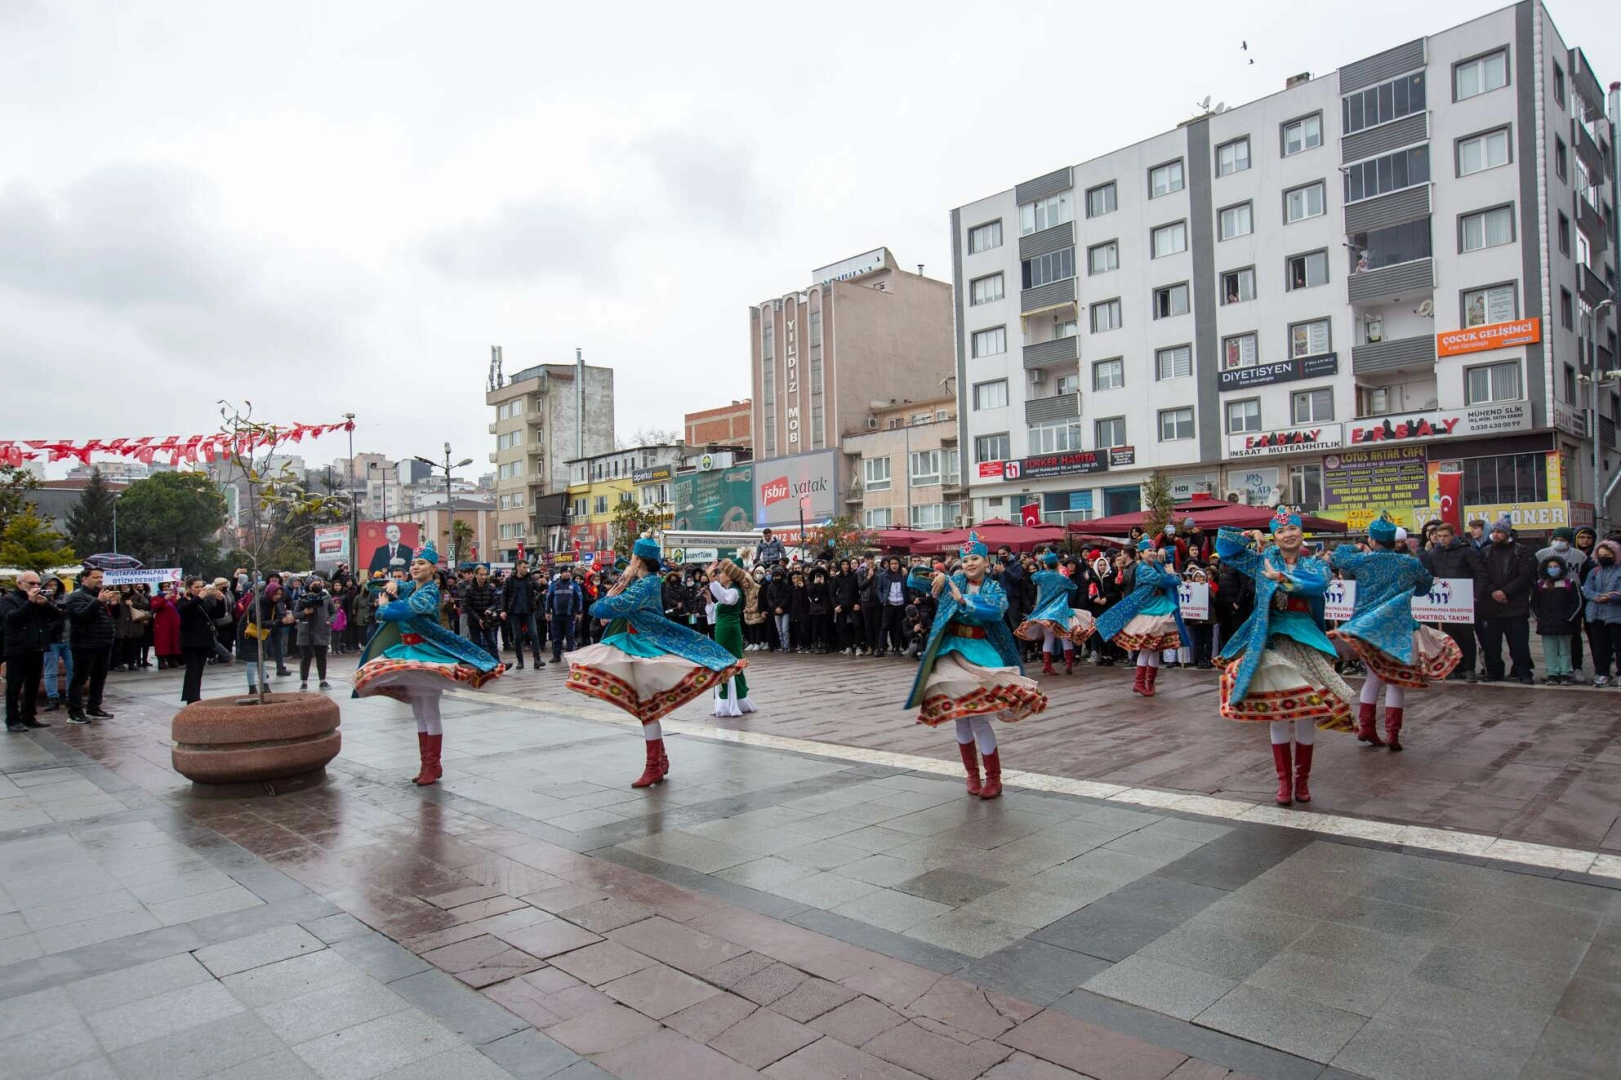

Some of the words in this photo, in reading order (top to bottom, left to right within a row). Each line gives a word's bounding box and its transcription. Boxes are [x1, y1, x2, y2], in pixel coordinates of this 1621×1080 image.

[1443, 333, 1477, 346] ÇOCUK
[1479, 322, 1533, 338] GELİŞİMCİ
[787, 319, 797, 393] YILDIZ
[789, 407, 799, 442] MOB
[1351, 418, 1459, 444] ERBAY
[1245, 428, 1321, 449] ERBAY
[1341, 452, 1368, 463] LOTUS
[1371, 449, 1399, 461] AKTAR
[792, 477, 827, 498] yatak
[1174, 485, 1189, 493] HDI
[1568, 562, 1580, 573] M
[112, 577, 133, 585] OTİZM
